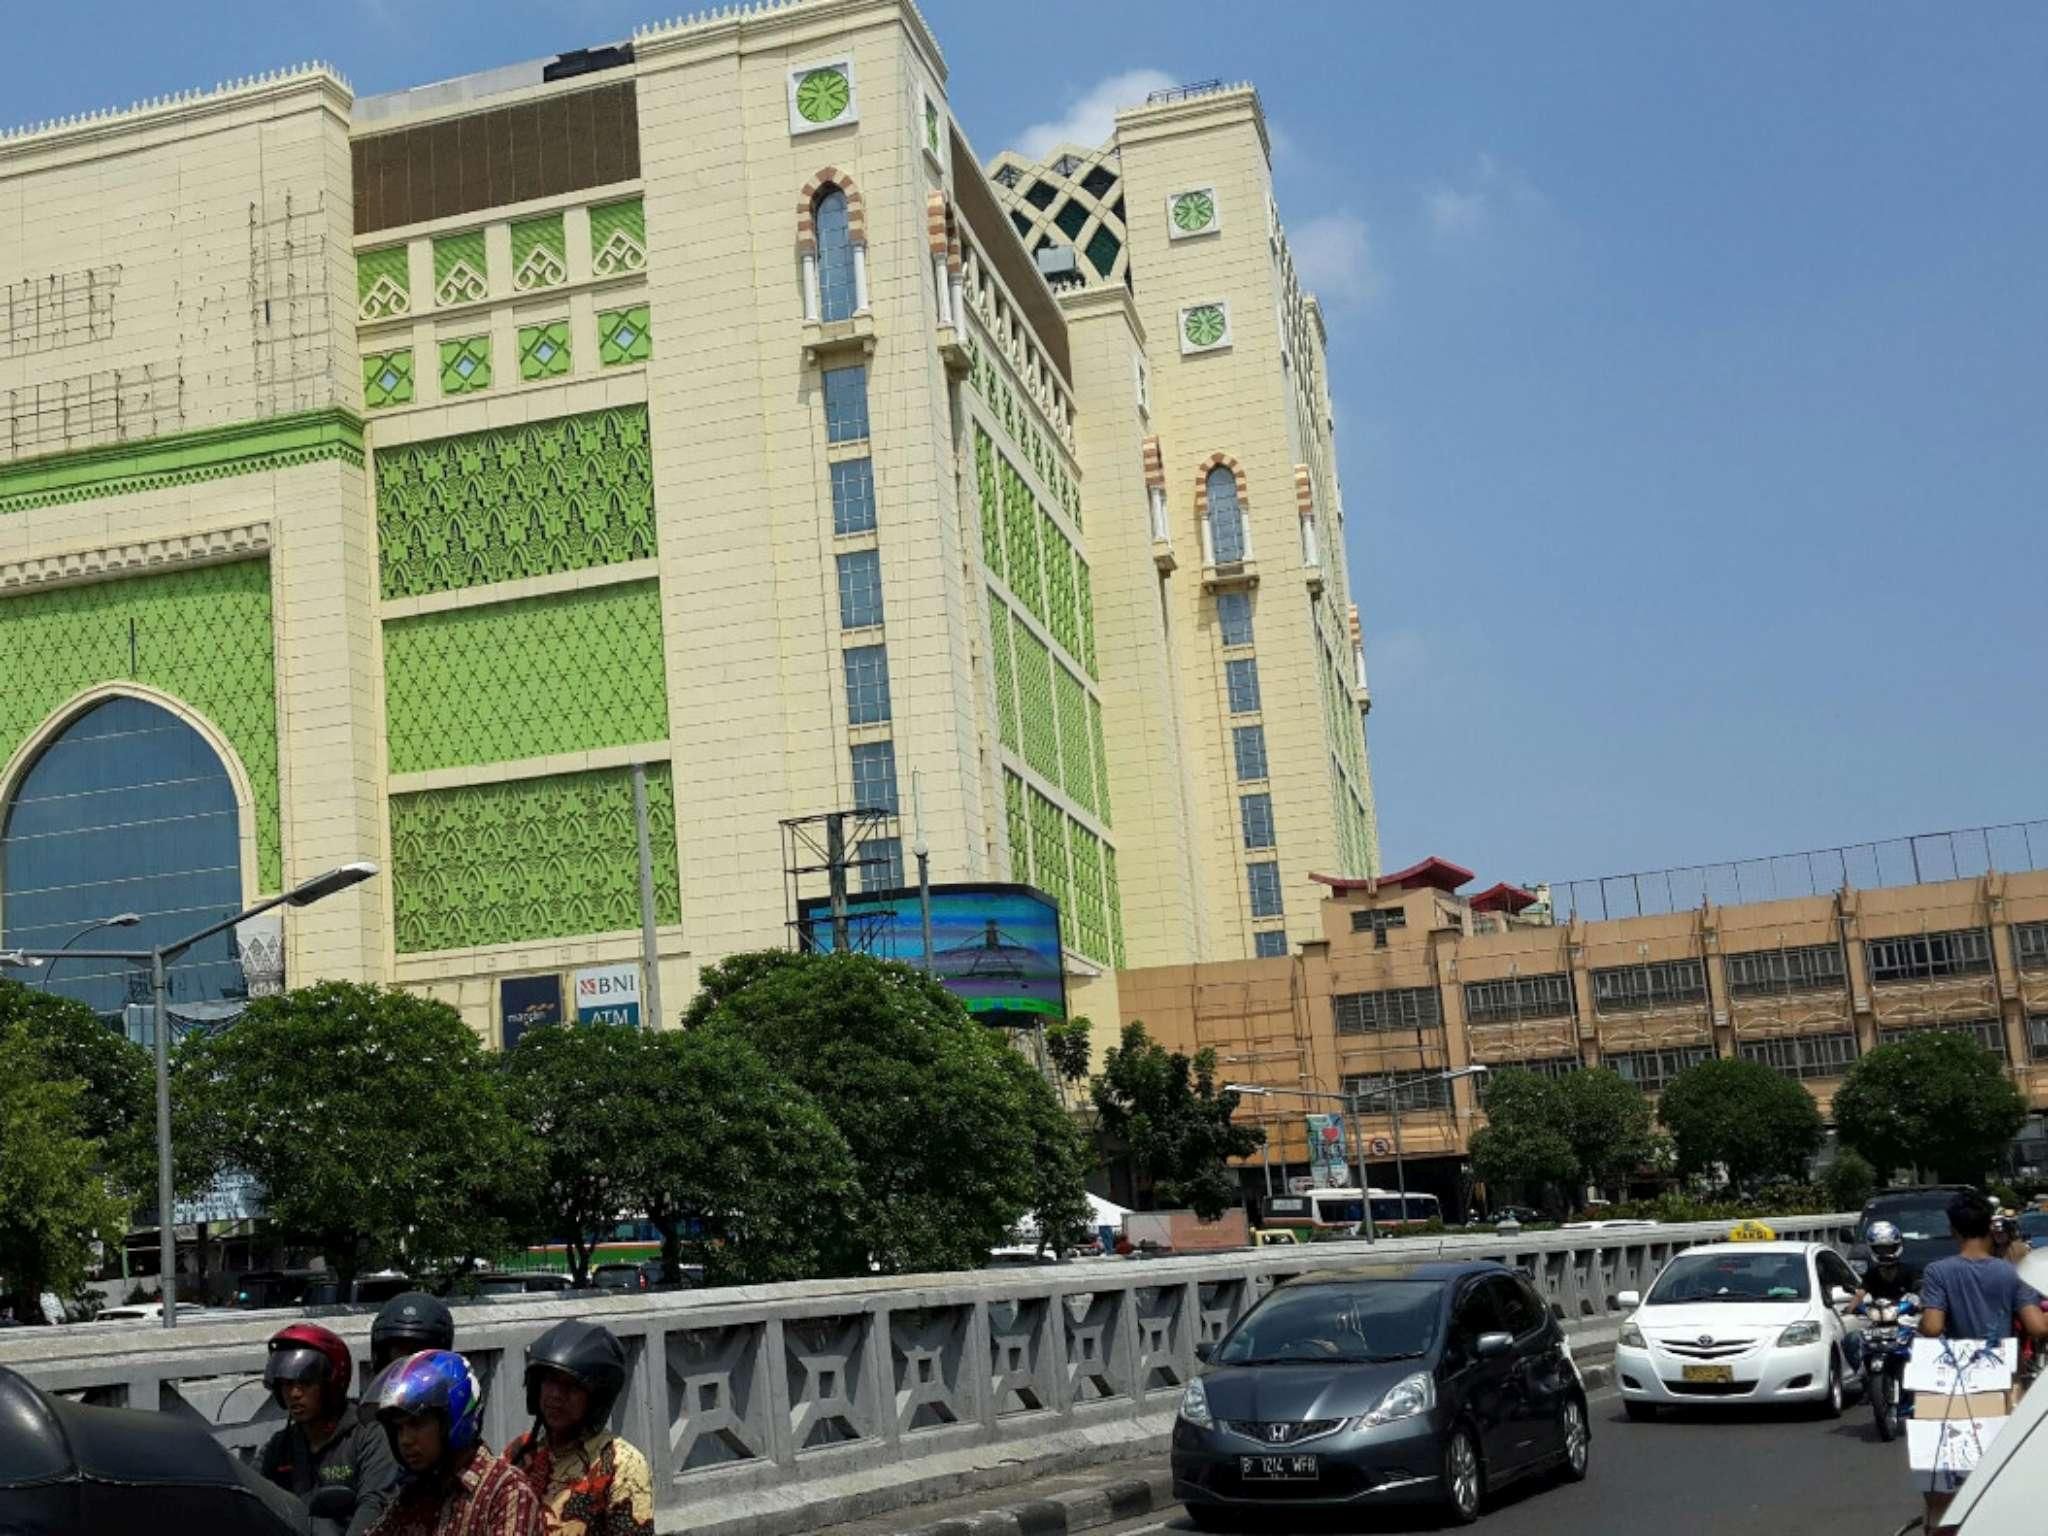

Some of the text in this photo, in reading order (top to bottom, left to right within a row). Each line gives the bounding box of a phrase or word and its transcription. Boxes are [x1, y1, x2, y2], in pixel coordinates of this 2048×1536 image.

[599, 975, 635, 995] BNI
[507, 1011, 546, 1024] mand
[591, 1009, 629, 1025] ATM
